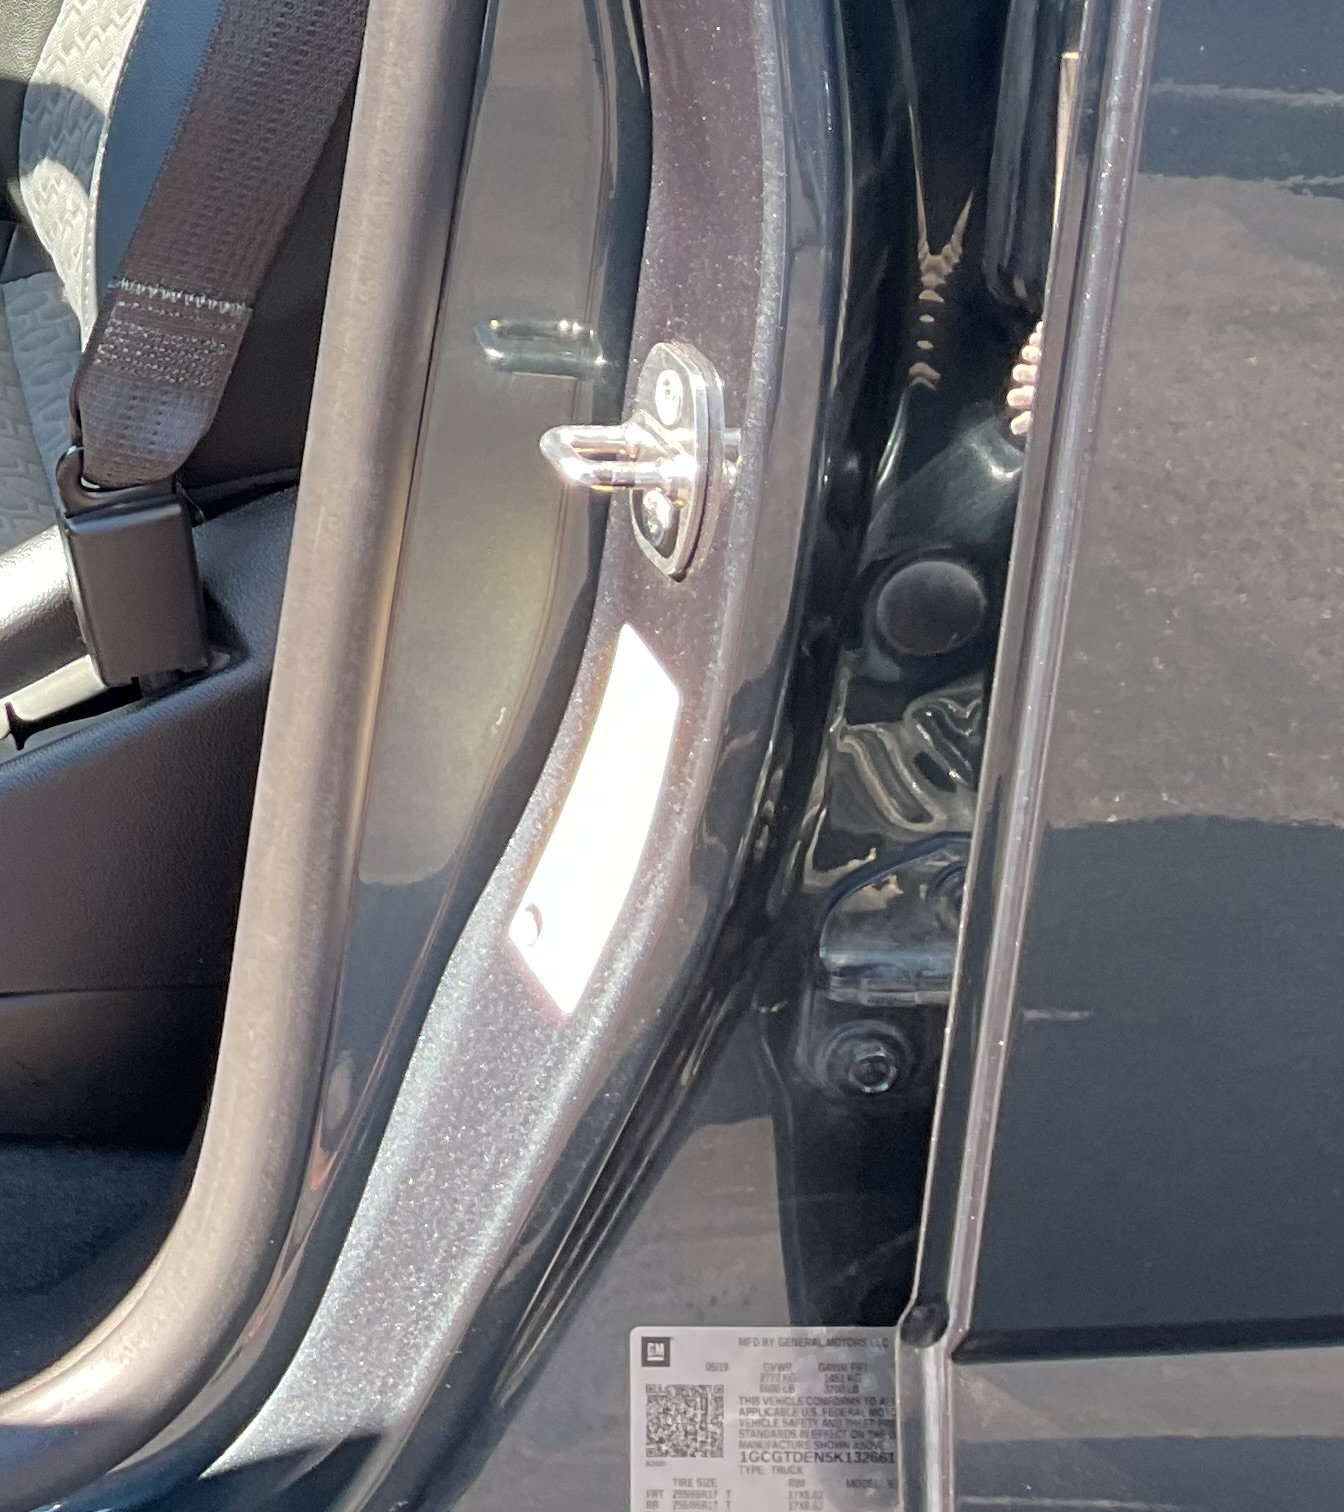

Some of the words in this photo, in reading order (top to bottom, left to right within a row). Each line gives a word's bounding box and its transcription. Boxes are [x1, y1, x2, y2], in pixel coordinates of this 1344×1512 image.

[739, 1337, 759, 1347] MFD
[762, 1337, 775, 1347] BY
[778, 1337, 824, 1347] GENERAL
[826, 1337, 866, 1347] MOTORS
[763, 1362, 792, 1373] GVWR
[739, 1396, 760, 1406] THIS
[763, 1396, 805, 1406] VEHICLE
[864, 1396, 877, 1406] TO
[739, 1407, 799, 1417] APPLICABLE
[822, 1407, 863, 1417] FEDERAL
[739, 1418, 779, 1428] VEHICLE
[782, 1418, 819, 1428] SAFETY
[739, 1429, 797, 1439] STANDARDS
[799, 1429, 810, 1439] IN
[811, 1429, 848, 1439] EFFECT
[739, 1440, 812, 1450] MANUFACTURE
[814, 1440, 849, 1450] SHOWN
[771, 1465, 804, 1475] TRUCK
[672, 1477, 694, 1488] TIRE
[696, 1477, 719, 1488] SIZE
[646, 1489, 664, 1499] FRT
[725, 1489, 733, 1499] T
[646, 1499, 659, 1510] RR
[725, 1499, 733, 1510] T
